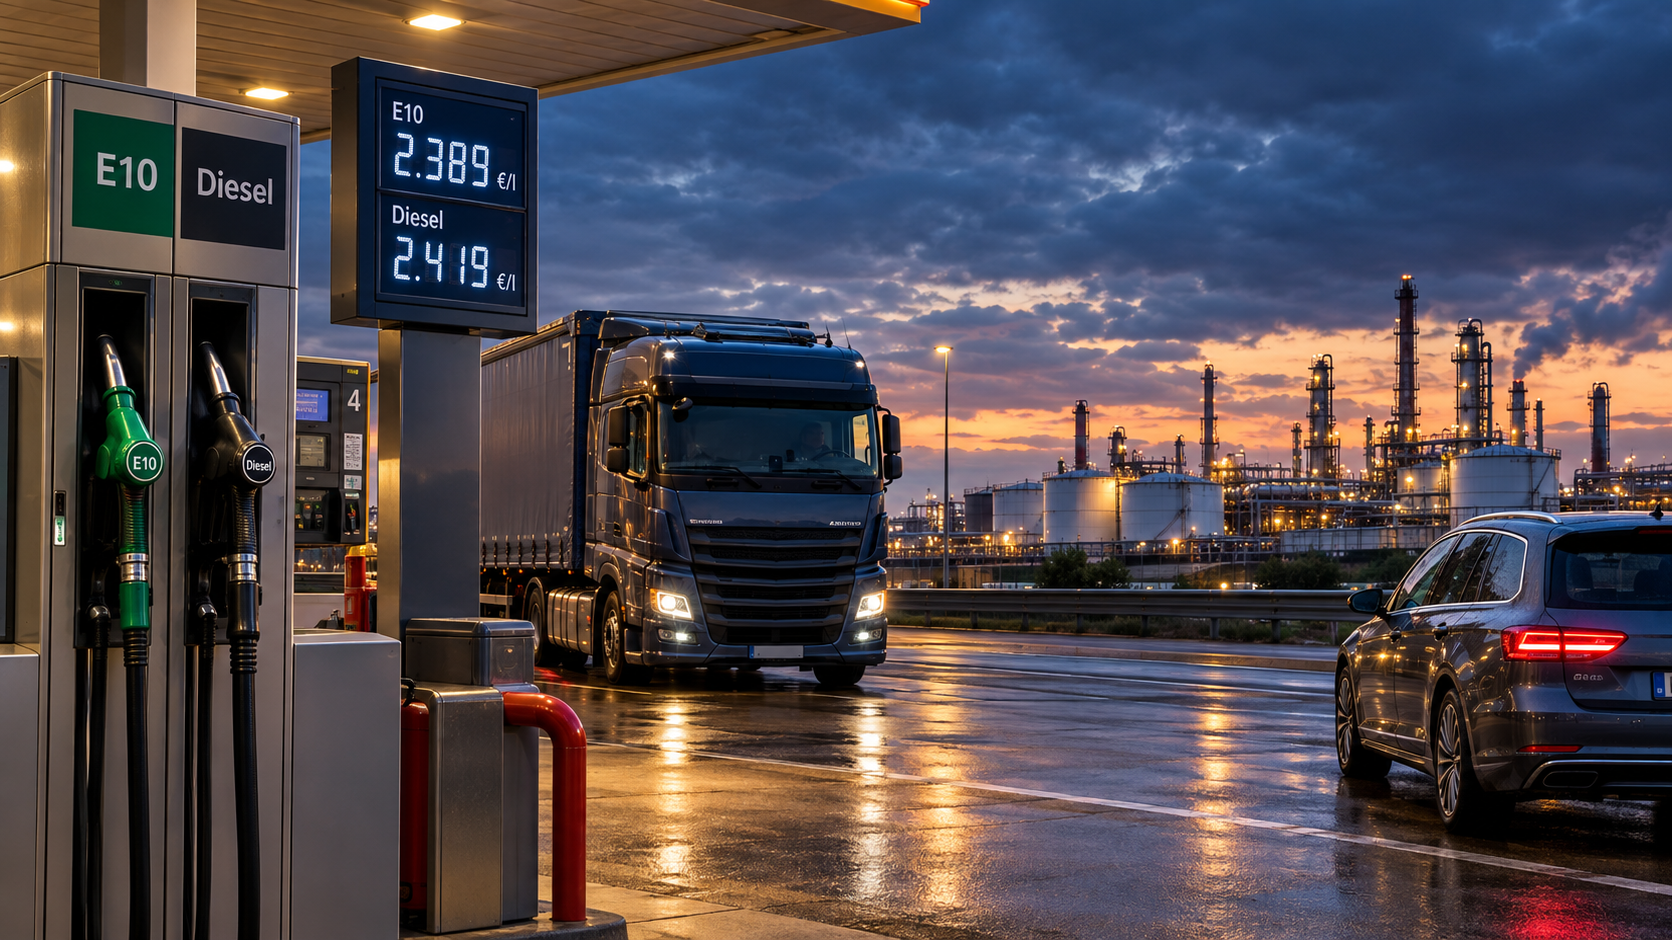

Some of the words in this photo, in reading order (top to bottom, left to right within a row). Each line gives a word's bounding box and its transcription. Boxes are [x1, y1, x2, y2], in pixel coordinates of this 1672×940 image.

[393, 100, 424, 124] E10
[96, 151, 158, 192] E10
[394, 131, 490, 189] 2.389
[197, 167, 273, 205] Diesel
[392, 204, 443, 230] Diesel
[393, 235, 489, 289] 2.419
[347, 388, 361, 412] 4
[133, 456, 157, 471] E10
[246, 459, 272, 472] Diesel
